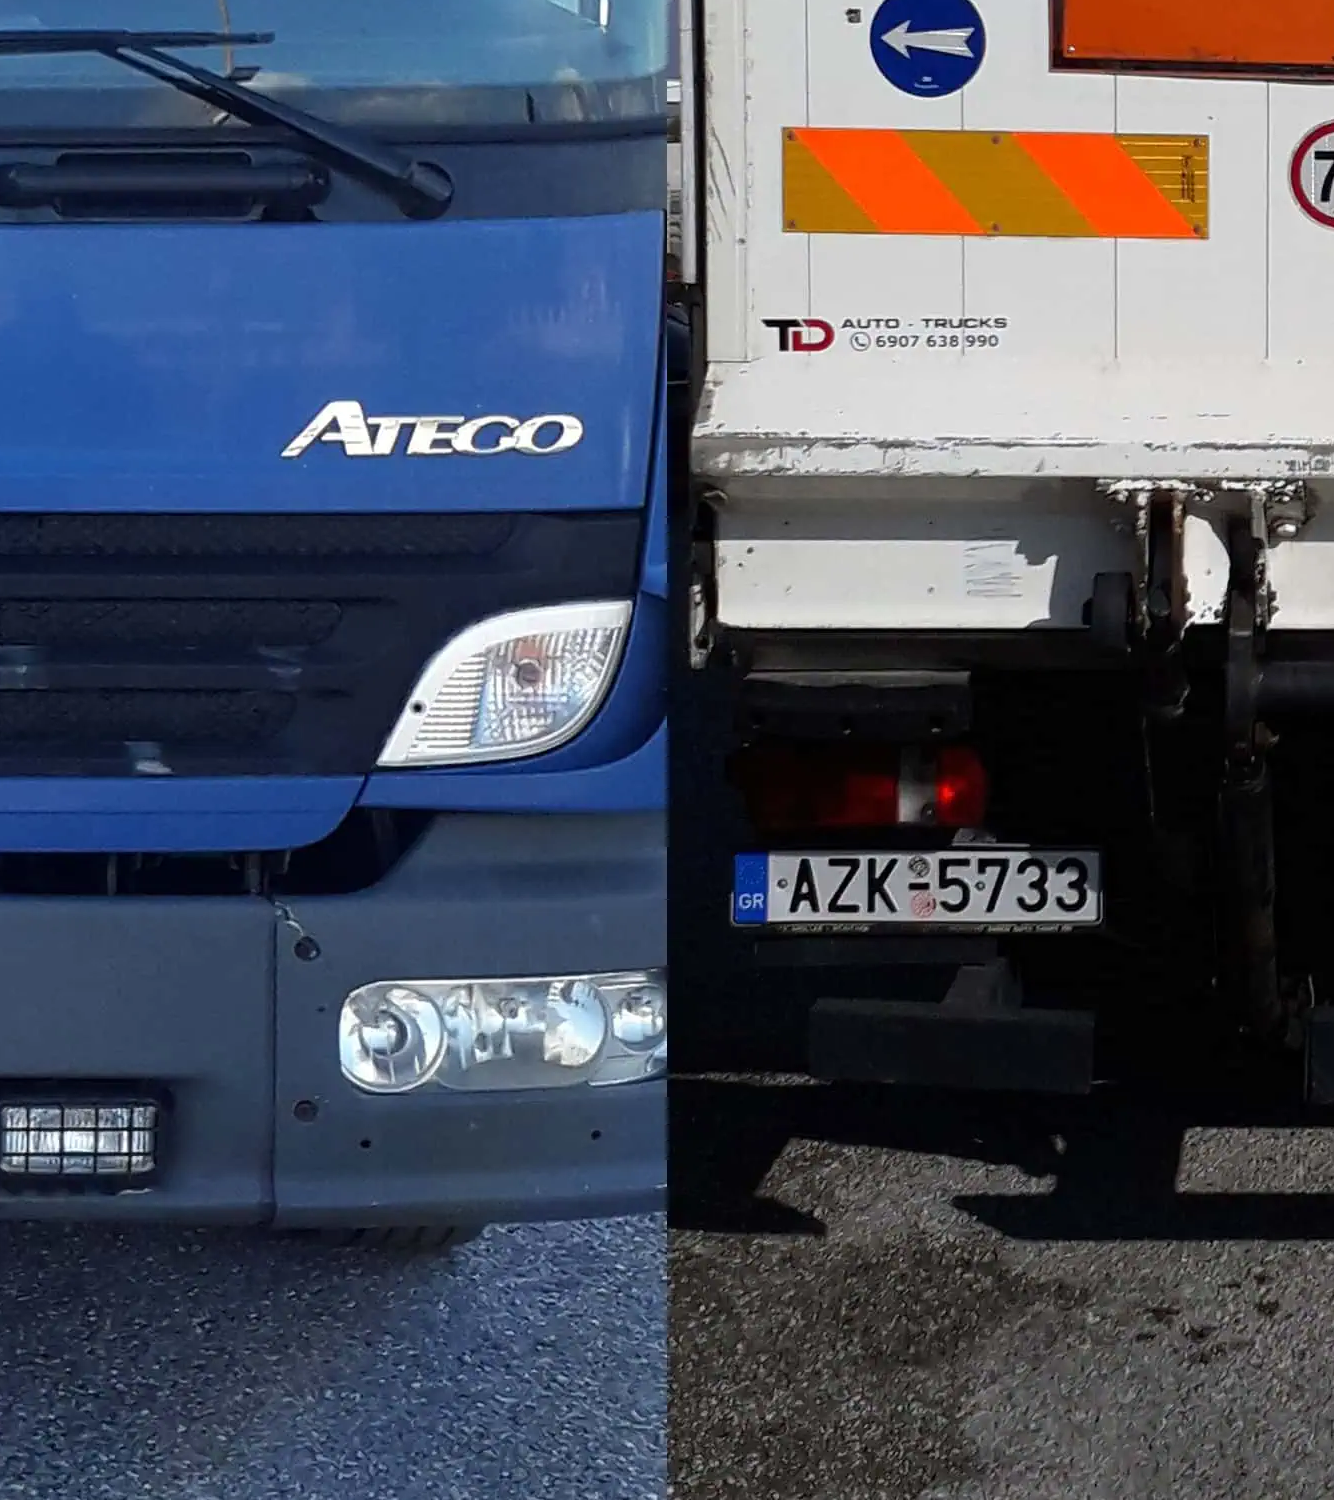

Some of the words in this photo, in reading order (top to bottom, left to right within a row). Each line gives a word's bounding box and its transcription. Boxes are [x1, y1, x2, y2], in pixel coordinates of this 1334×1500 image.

[841, 318, 900, 329] AUTO
[921, 318, 1008, 329] TRUCKS
[760, 317, 836, 352] TD
[875, 335, 919, 348] 6907
[926, 335, 959, 348] 638
[965, 335, 999, 348] 990
[788, 857, 1090, 914] AZK-5733
[738, 894, 764, 910] GR
